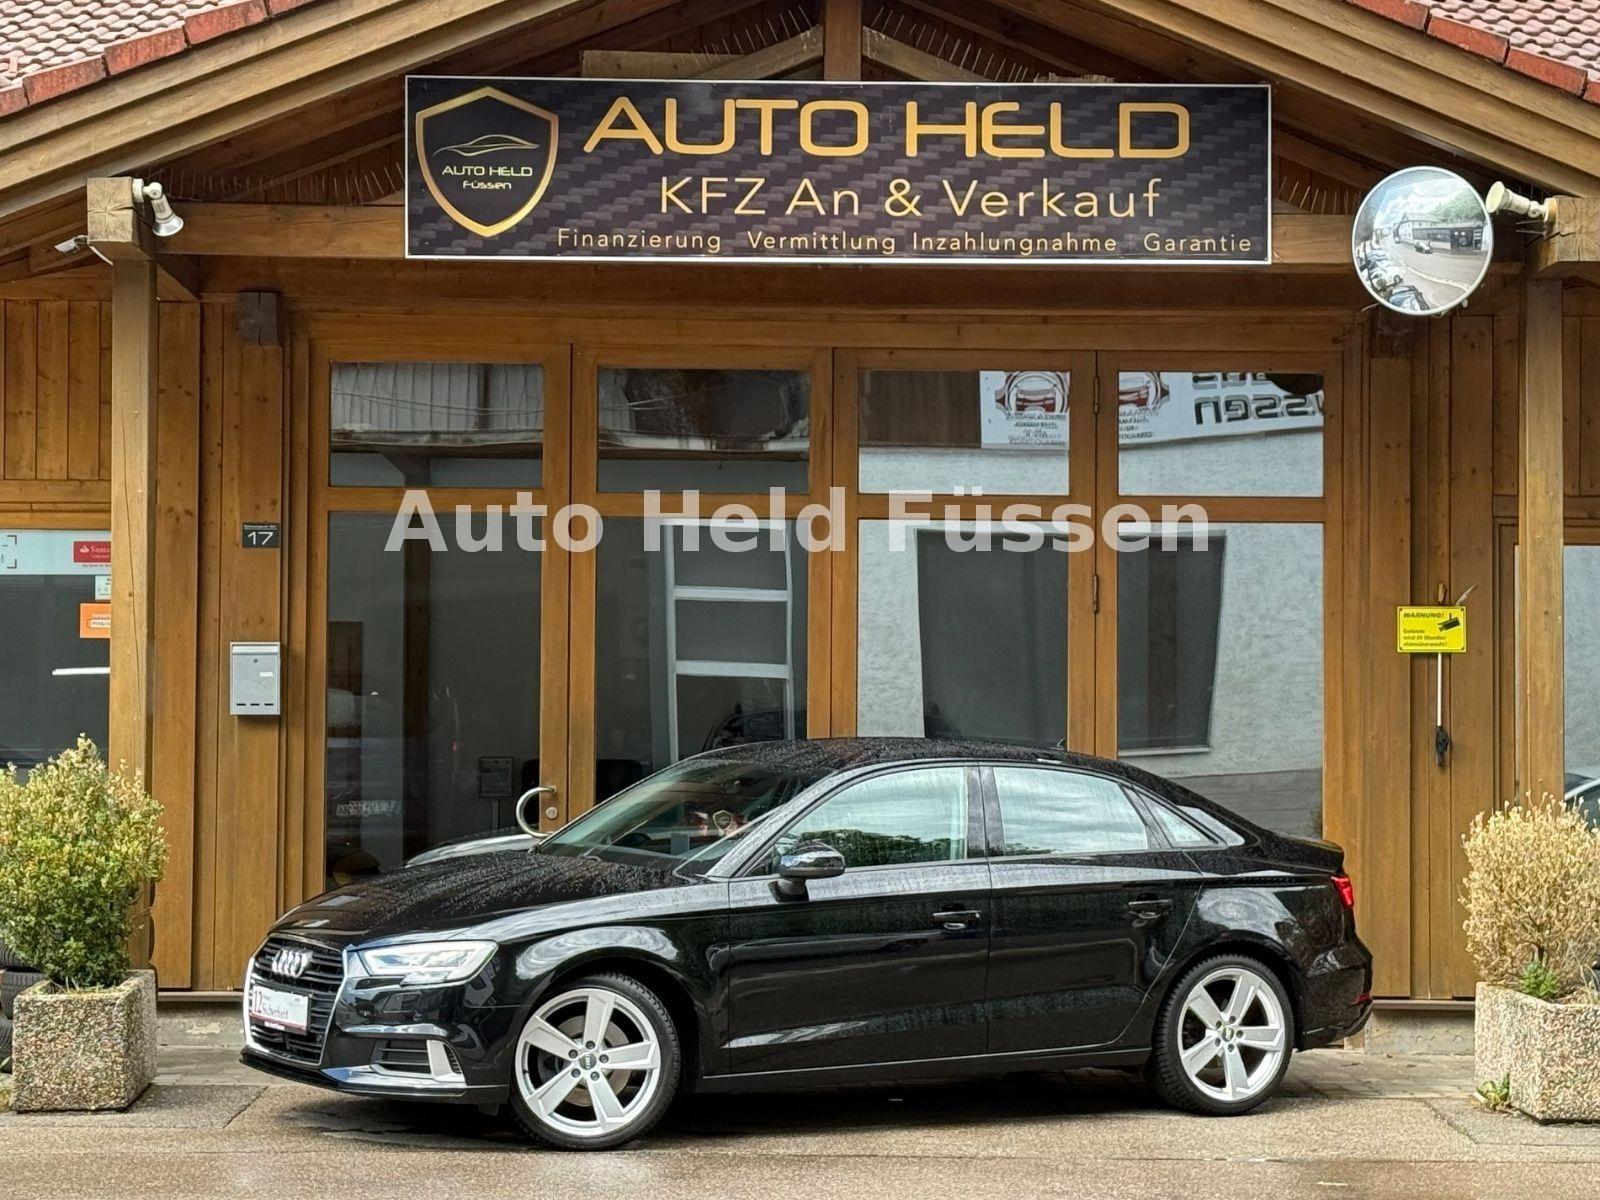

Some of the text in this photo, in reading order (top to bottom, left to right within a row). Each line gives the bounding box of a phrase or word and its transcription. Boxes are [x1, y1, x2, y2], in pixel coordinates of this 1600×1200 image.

[583, 96, 1190, 158] AUTO HELD
[442, 165, 533, 177] AUTO HELD
[462, 180, 512, 190] Füssen
[660, 176, 1162, 218] KFZ An & Verkauf
[557, 227, 1252, 256] Finanzierung Vermittlung Inzahlungnahme Garantie
[247, 530, 274, 546] 17
